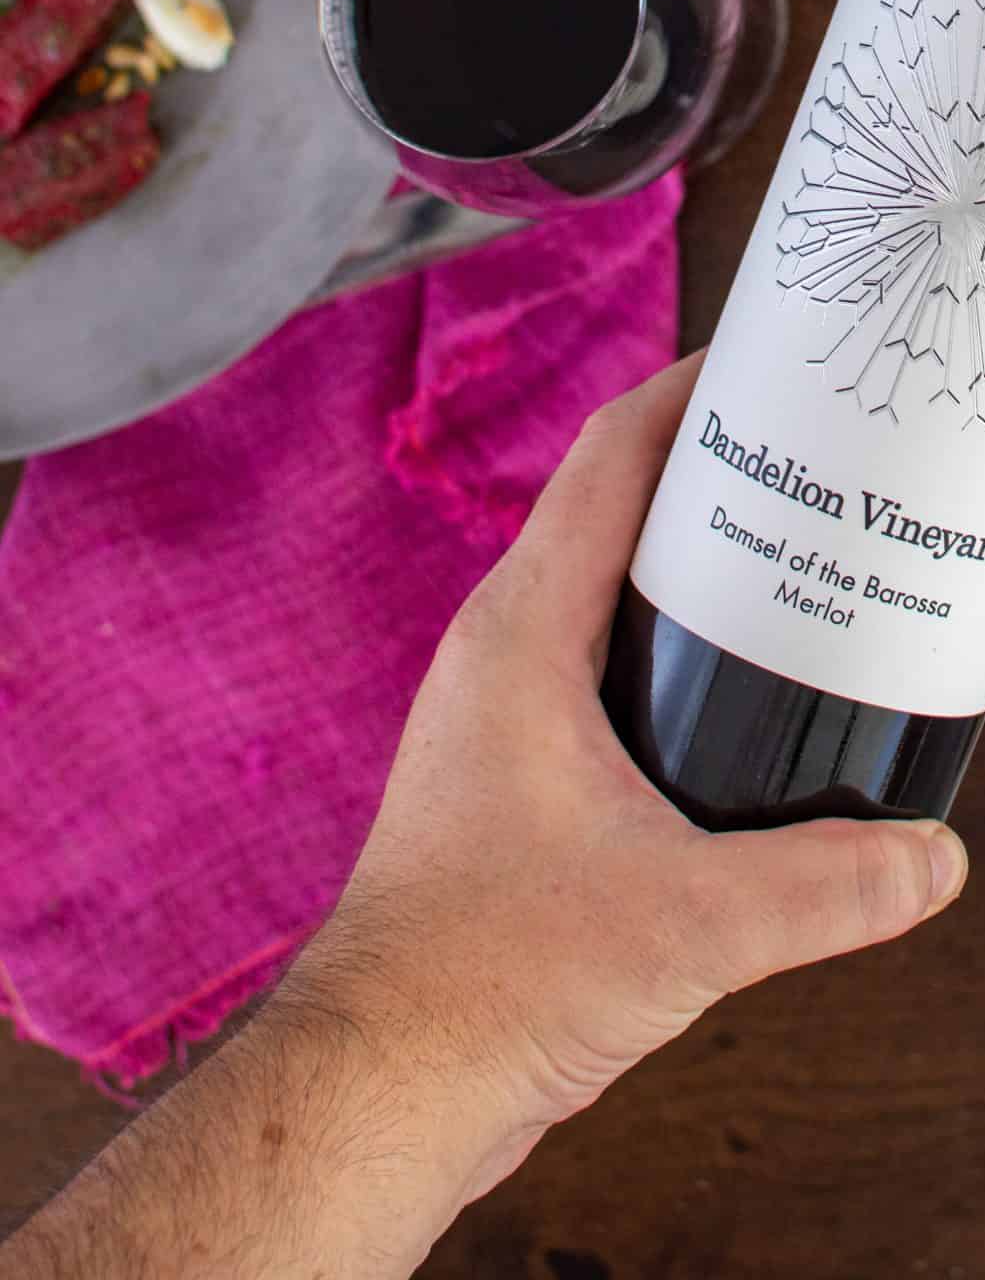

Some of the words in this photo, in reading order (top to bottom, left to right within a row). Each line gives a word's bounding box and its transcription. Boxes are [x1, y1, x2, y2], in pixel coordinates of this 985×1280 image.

[698, 410, 845, 519] Dandelion
[710, 506, 787, 564] Damsel
[790, 552, 819, 575] of
[819, 560, 856, 592] the
[863, 575, 952, 618] Barossa
[774, 580, 855, 629] Merlot
